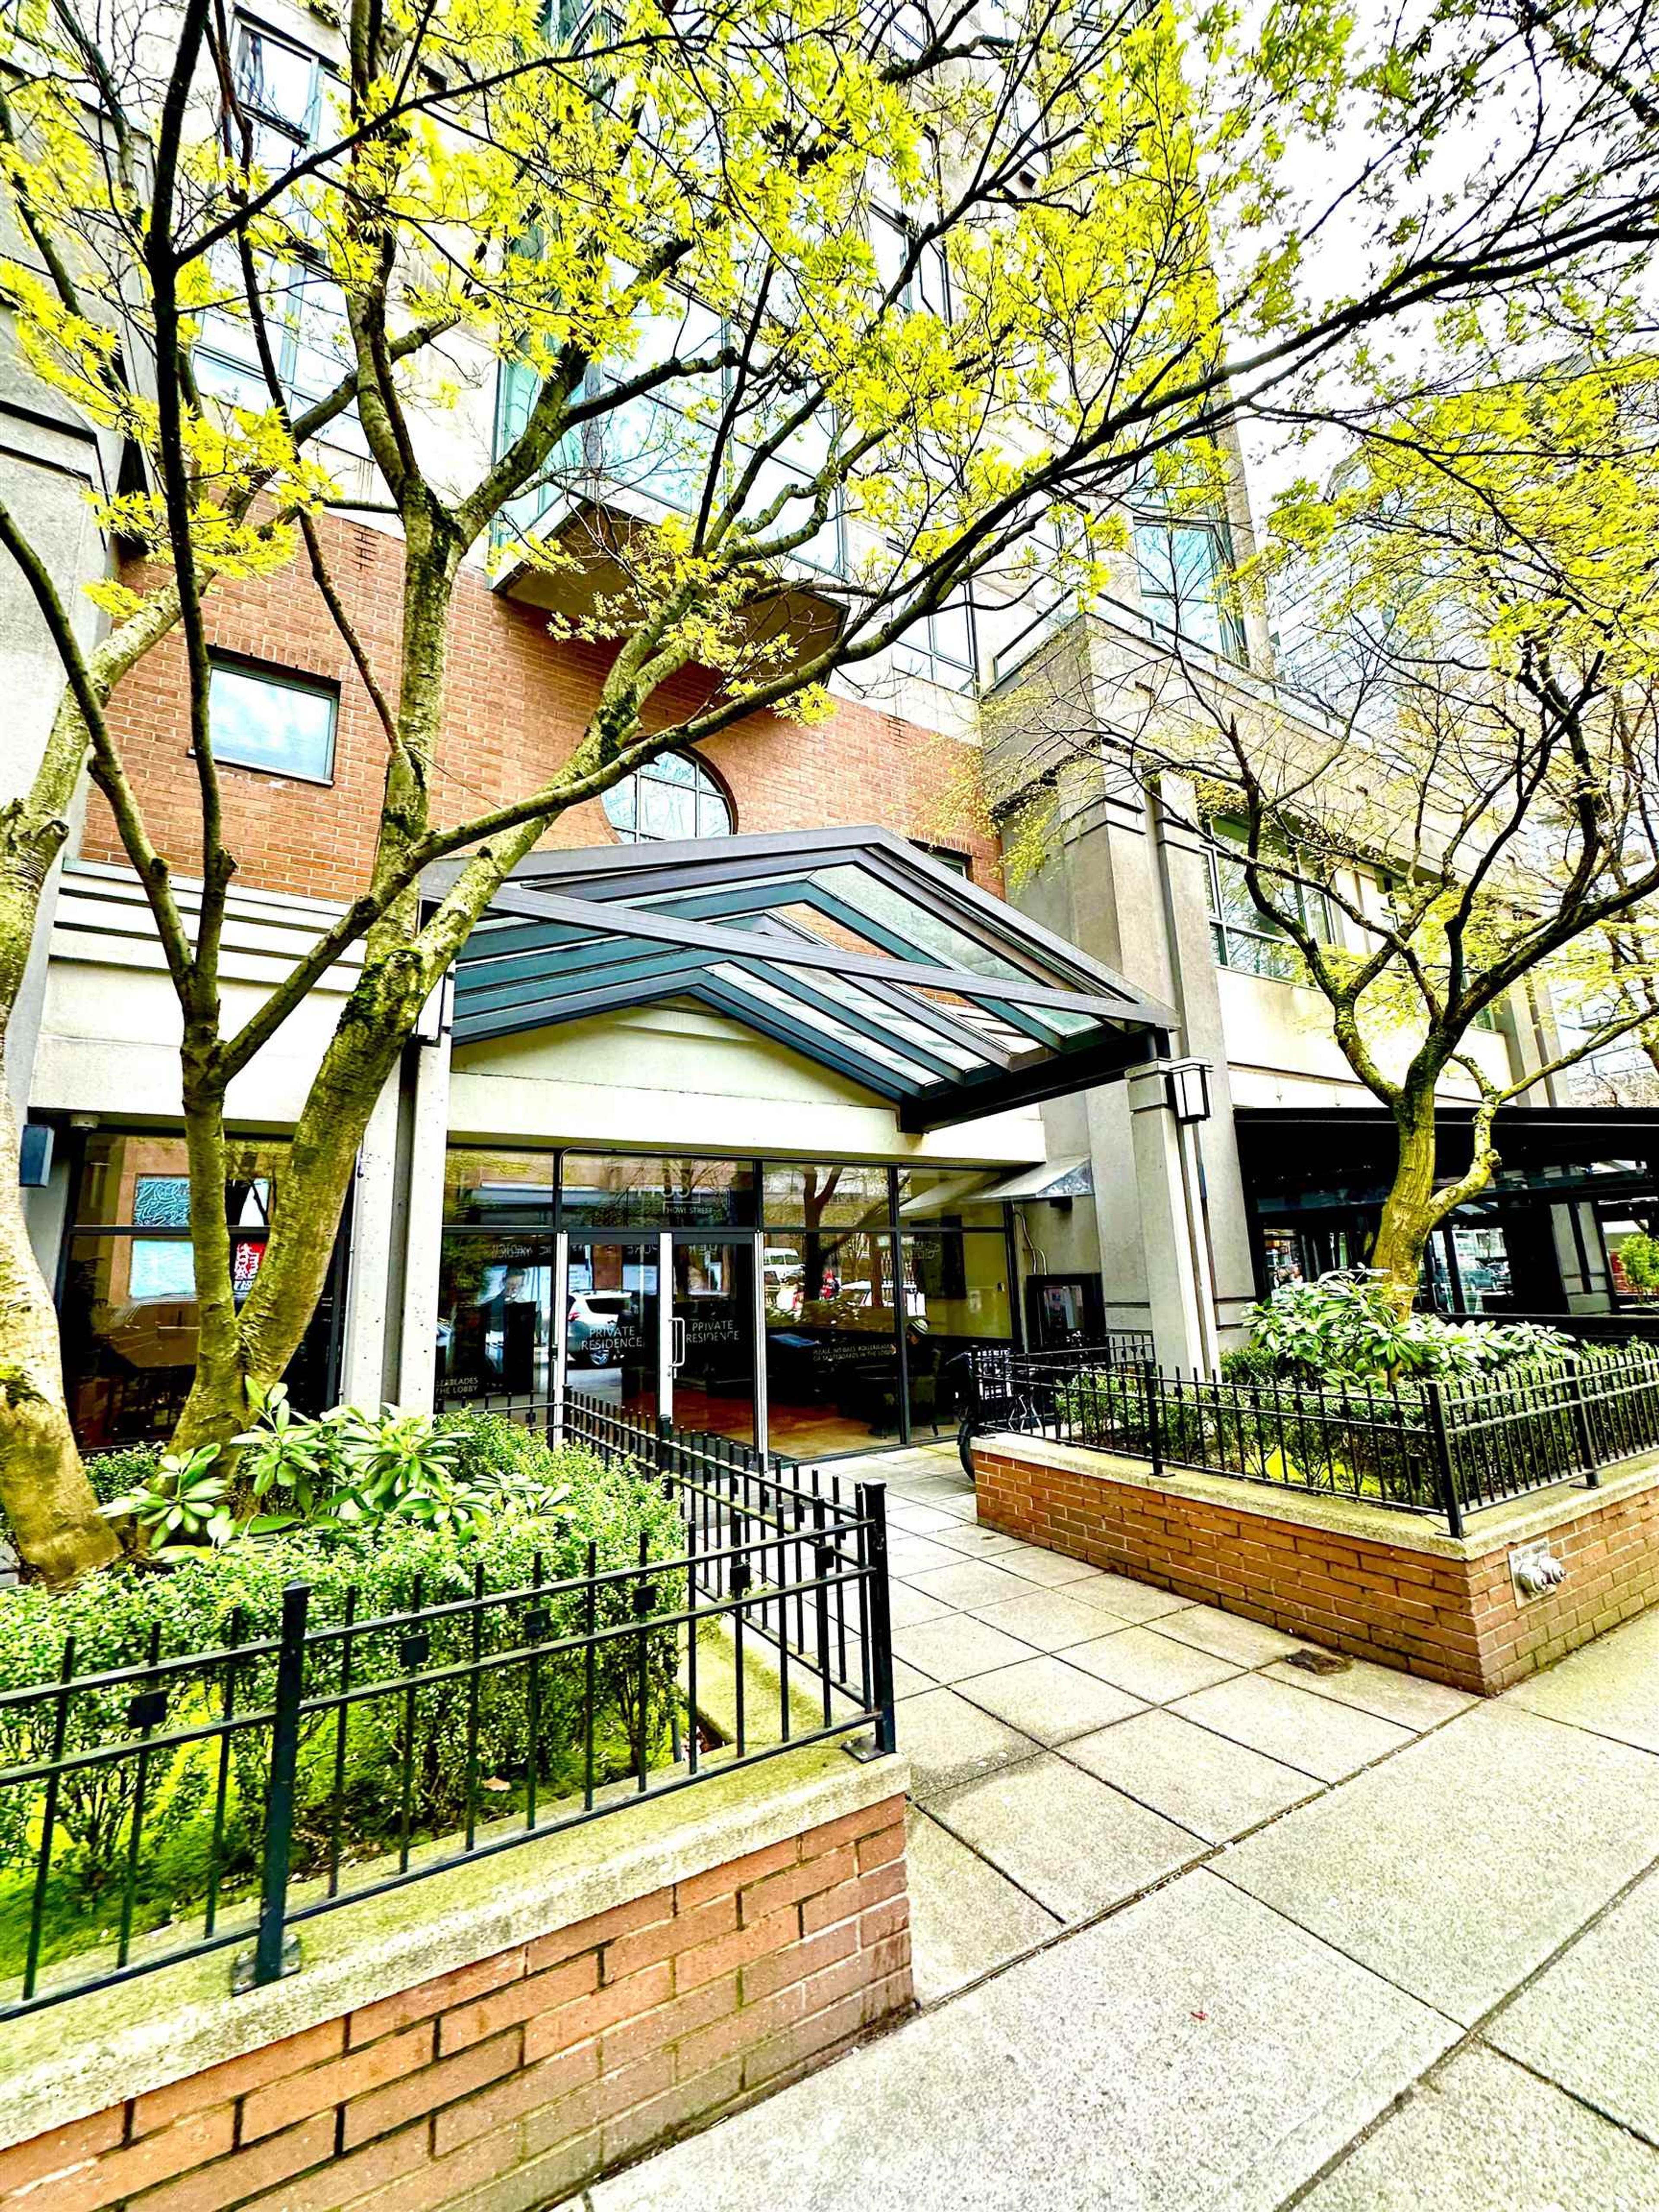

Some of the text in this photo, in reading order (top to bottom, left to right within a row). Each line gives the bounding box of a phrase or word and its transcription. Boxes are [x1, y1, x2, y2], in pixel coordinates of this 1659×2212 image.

[589, 1325, 635, 1338] PRIVATE
[692, 1320, 734, 1331] PRIVATE
[581, 1336, 642, 1351] RESIDENCE
[686, 1330, 740, 1344] RESIDENCE
[454, 1385, 478, 1394] LOBBY
